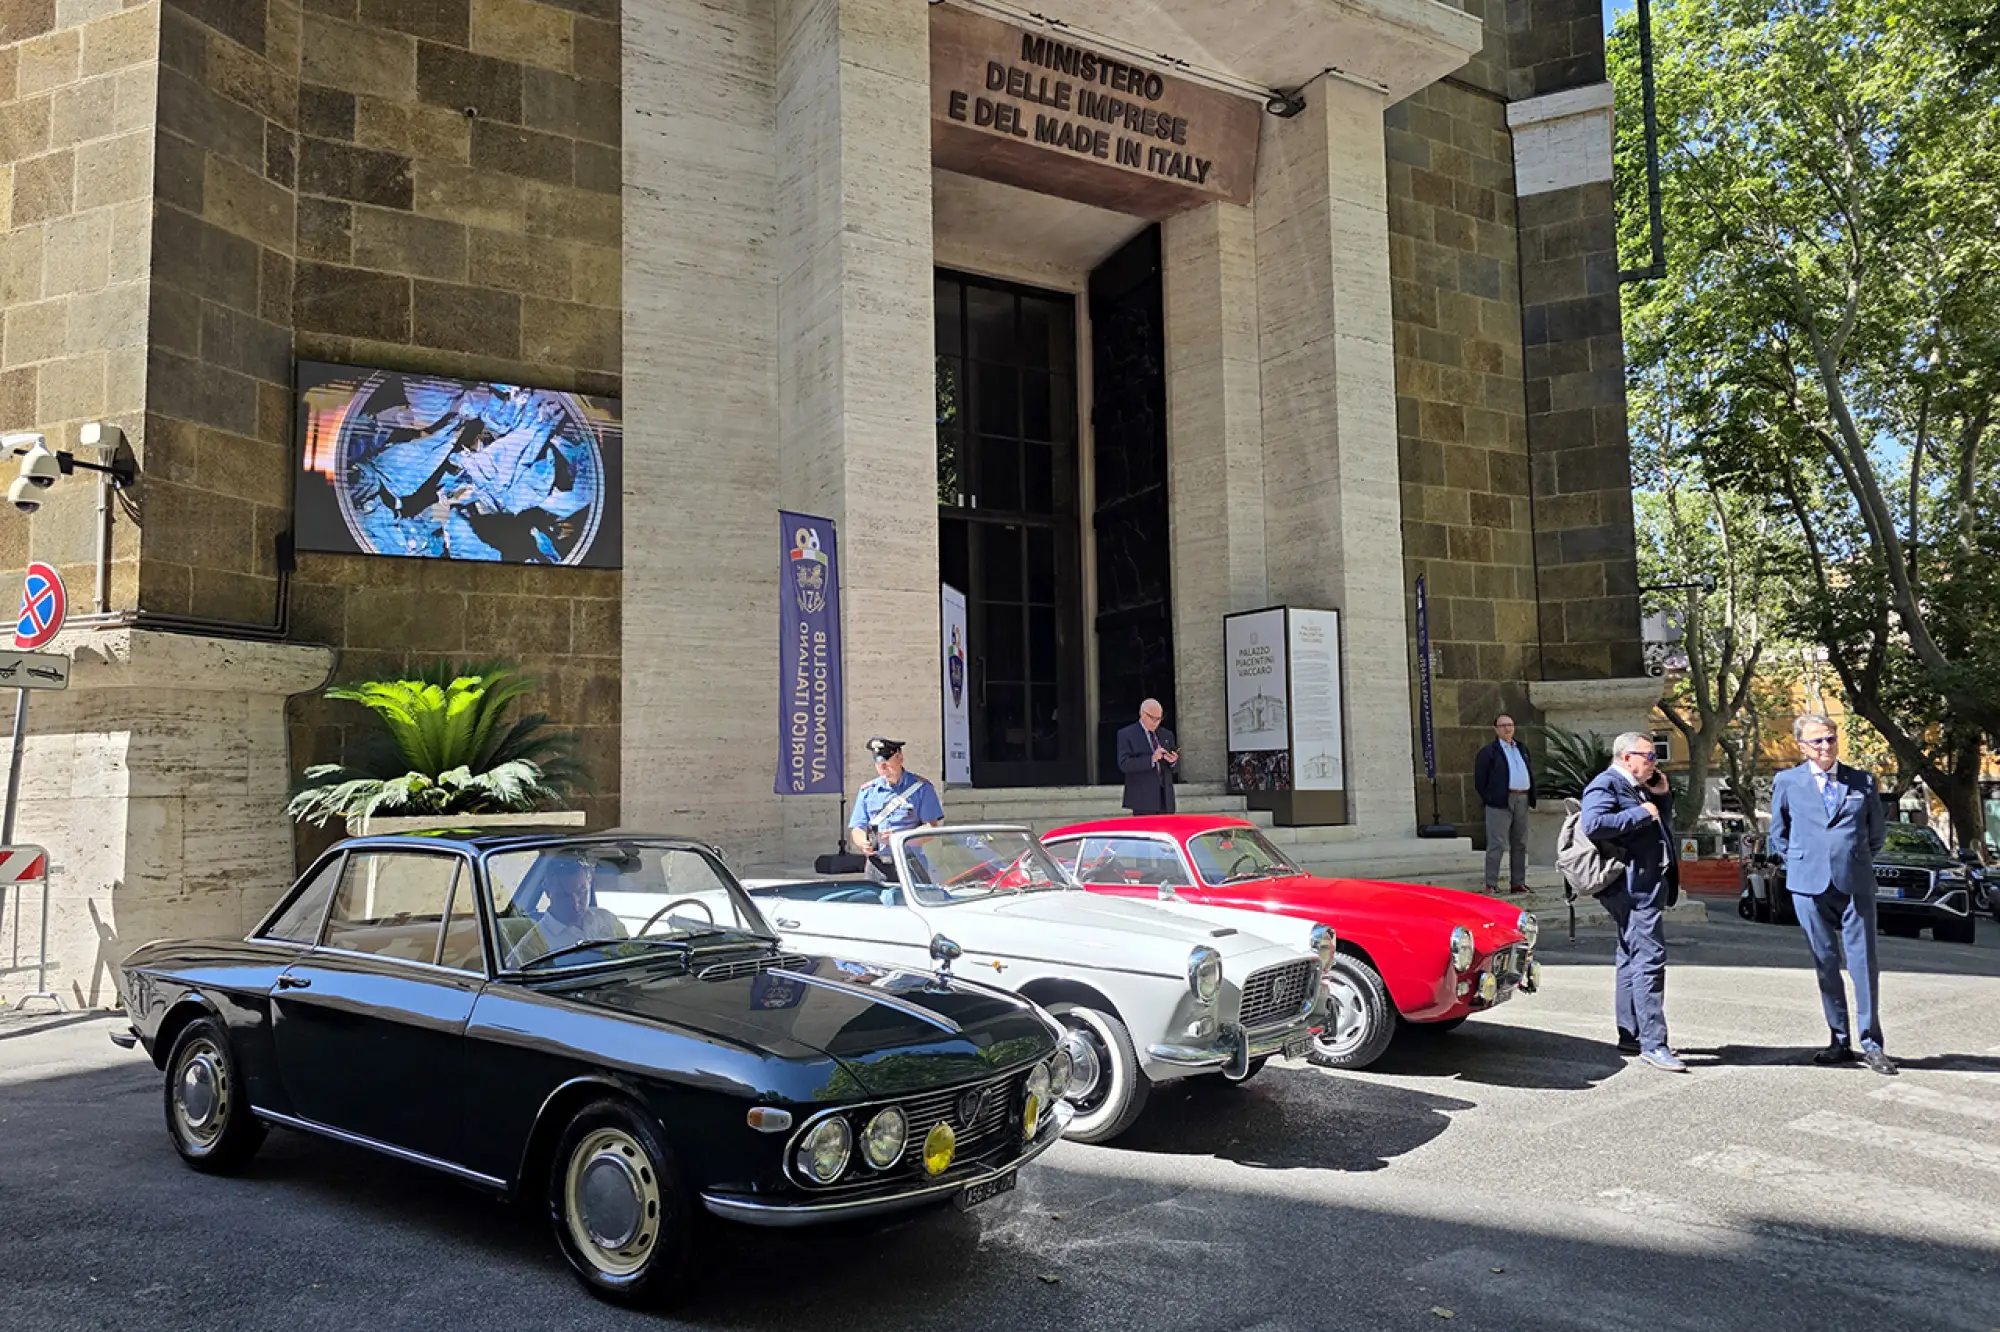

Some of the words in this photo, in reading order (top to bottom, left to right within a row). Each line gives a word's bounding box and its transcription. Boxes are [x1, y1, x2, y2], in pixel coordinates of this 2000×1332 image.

[1021, 32, 1164, 101] MINISTERO
[986, 60, 1073, 111] DELLE
[1077, 88, 1189, 145] IMPRESE
[949, 89, 968, 122] E
[974, 96, 1028, 138] DEL
[1035, 113, 1110, 160] MADE
[1116, 136, 1142, 168] IN
[1147, 146, 1212, 185] ITALY
[1235, 656, 1275, 667] PIACENTINI
[1238, 645, 1271, 656] PALAZZO
[1238, 666, 1272, 677] VACCARO
